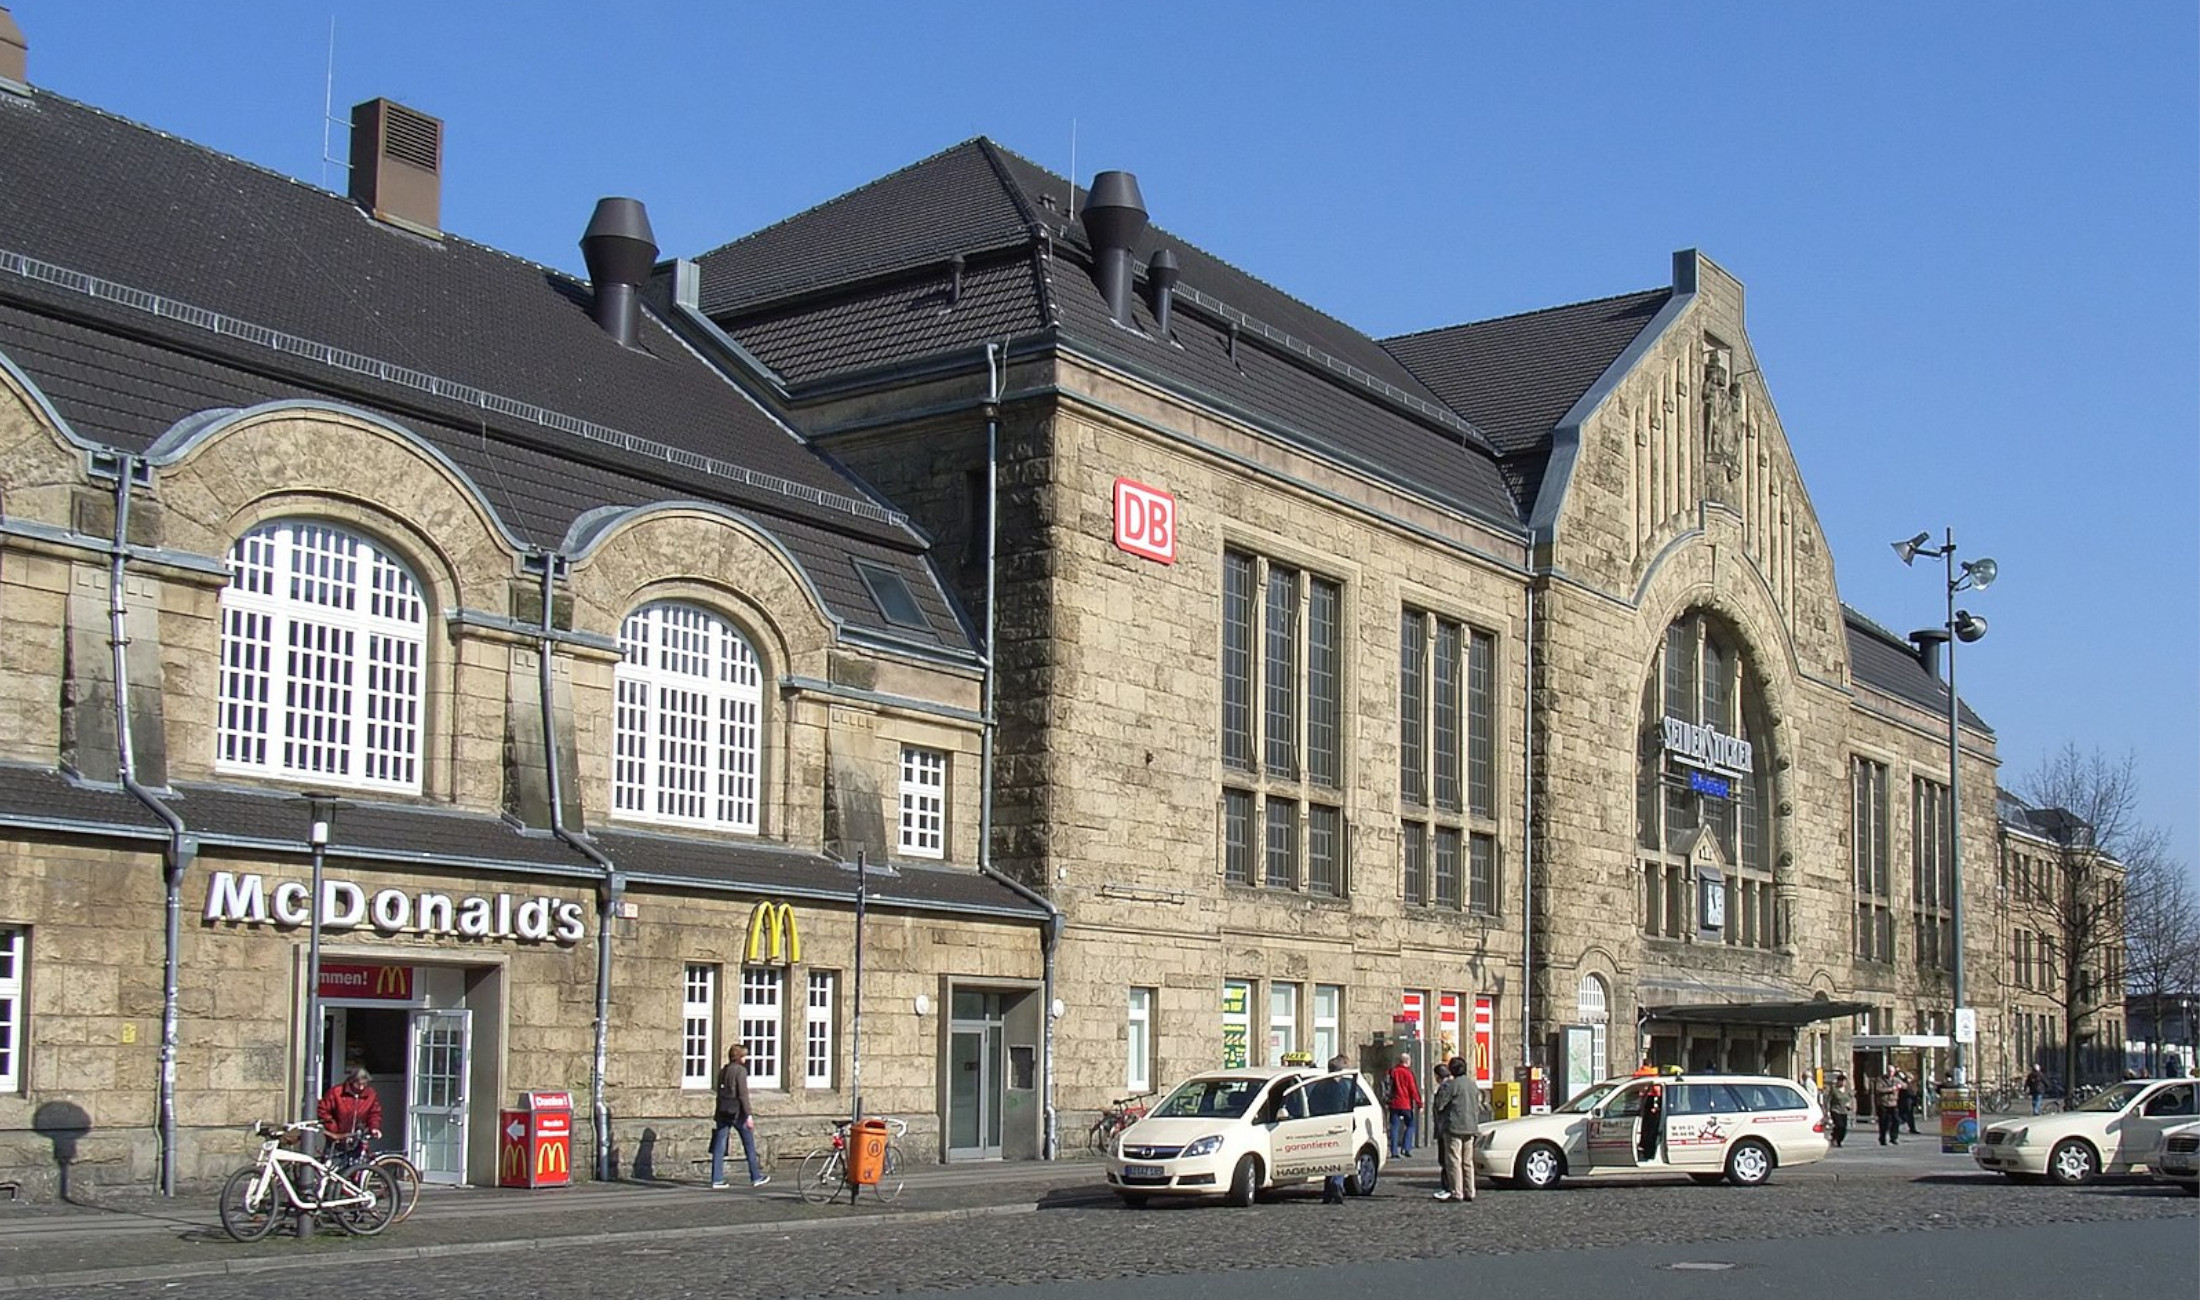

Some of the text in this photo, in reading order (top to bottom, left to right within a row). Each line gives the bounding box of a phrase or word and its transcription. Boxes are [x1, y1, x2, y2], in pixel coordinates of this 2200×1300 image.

[1124, 491, 1169, 549] DB
[1664, 715, 1753, 773] SEIDENSTICKER
[205, 871, 585, 941] McDonald's
[318, 971, 368, 986] mmen!
[1284, 1140, 1340, 1153] garantieren
[1276, 1164, 1341, 1176] HAGEMANN
